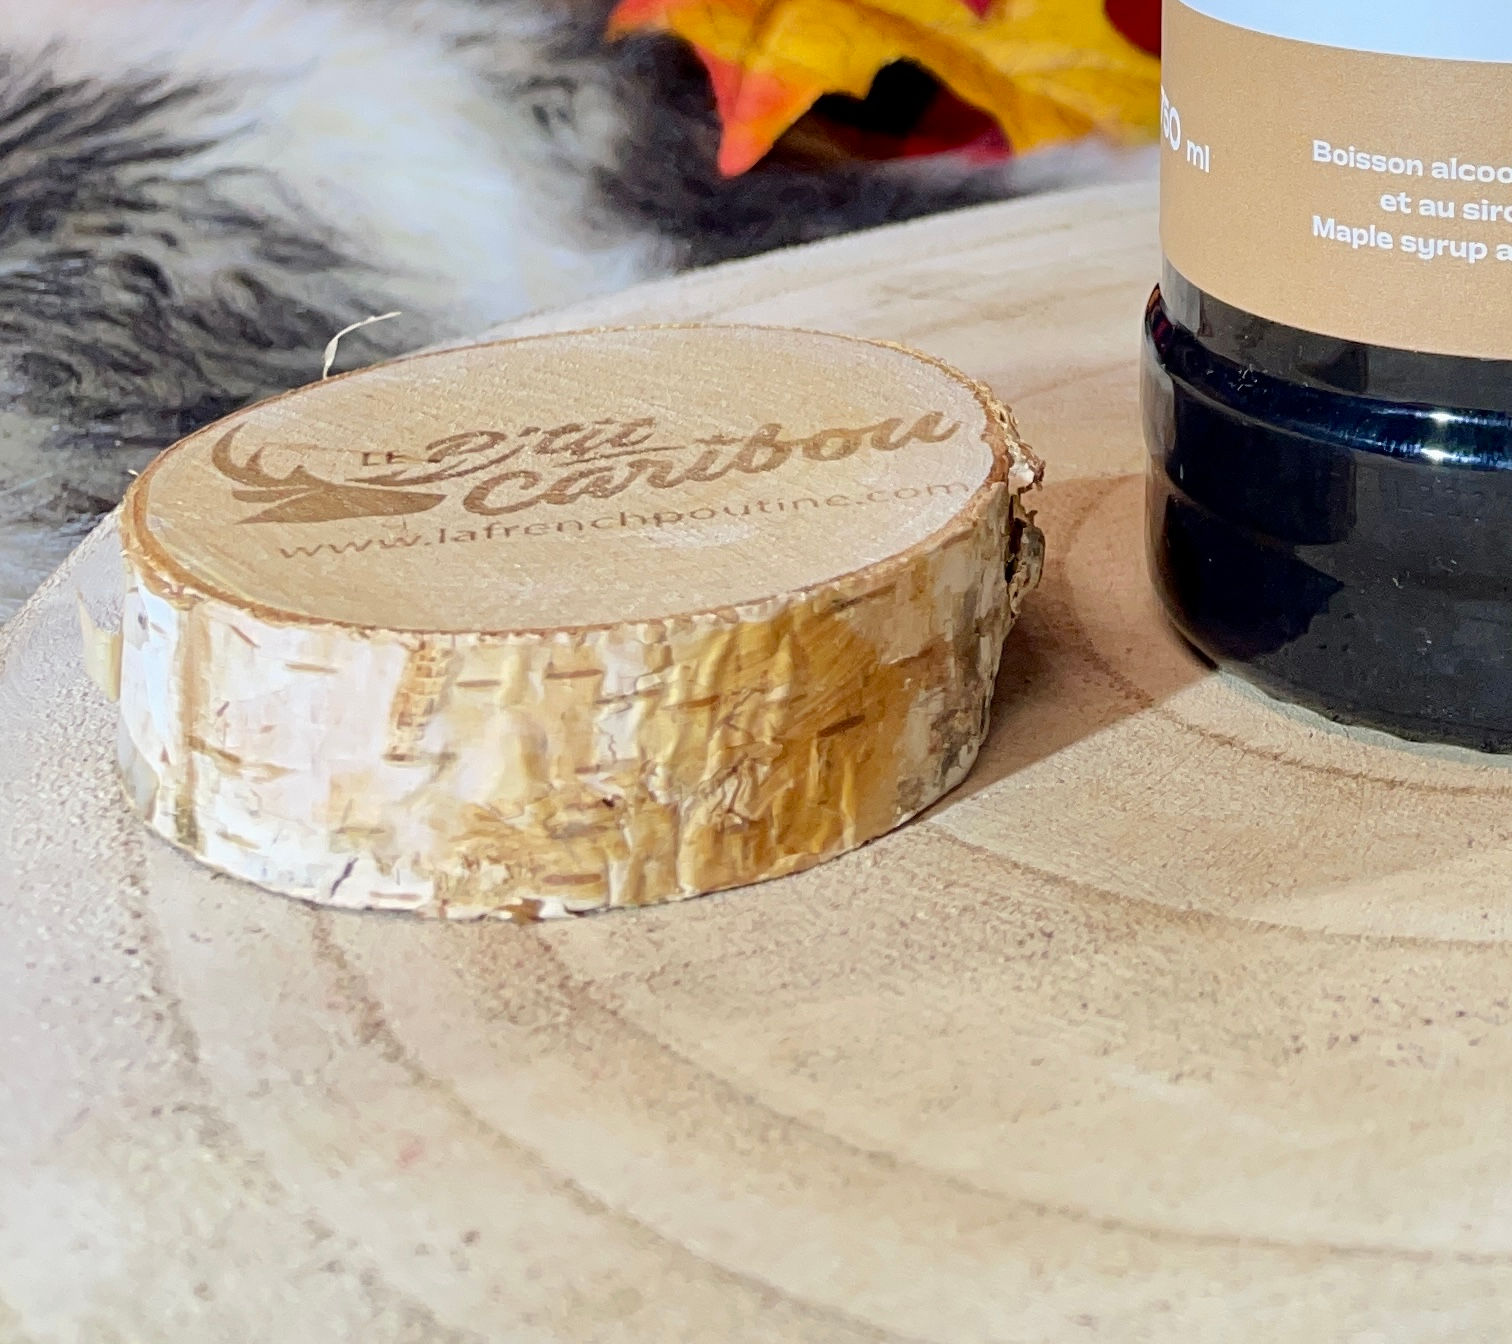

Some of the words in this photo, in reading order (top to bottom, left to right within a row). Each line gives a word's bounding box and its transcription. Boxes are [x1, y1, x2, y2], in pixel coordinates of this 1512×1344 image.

[1186, 139, 1210, 173] ml
[1312, 139, 1424, 177] Boisson
[1379, 191, 1412, 214] et
[1418, 198, 1455, 219] au
[1312, 215, 1394, 250] Maple
[1399, 234, 1488, 264] syrup
[463, 410, 963, 517] Caribou
[278, 479, 970, 560] www.lafrenchpoutine.com
